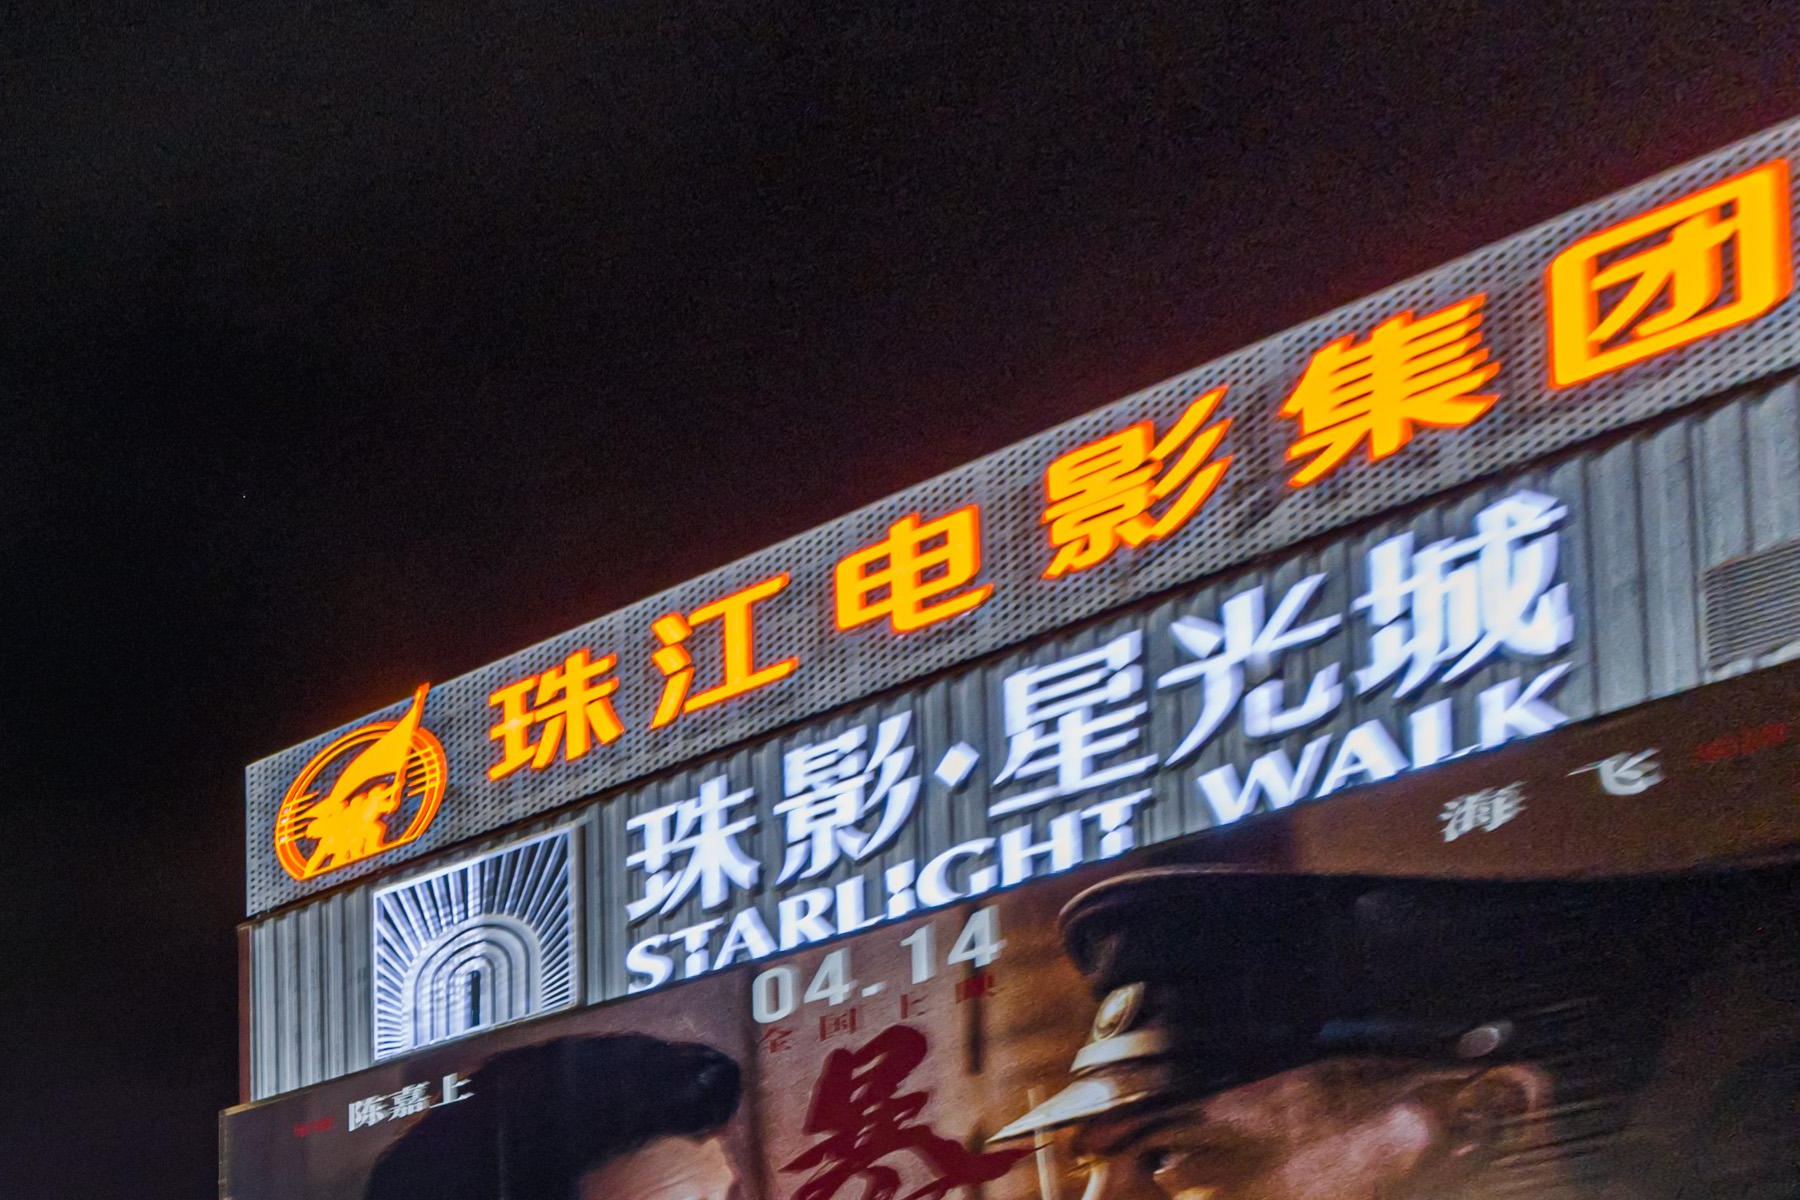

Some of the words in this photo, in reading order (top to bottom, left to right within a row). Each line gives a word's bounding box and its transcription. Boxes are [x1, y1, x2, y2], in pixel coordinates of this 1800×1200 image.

[486, 160, 1794, 784] 珠江电影集团
[625, 490, 1576, 922] 珠影·星光城
[625, 796, 1144, 994] STARLIGHT
[1197, 662, 1576, 828] WALK
[752, 905, 1006, 1024] 04.14
[760, 972, 996, 1053] 全国上映
[349, 1072, 475, 1131] 陈嘉上
